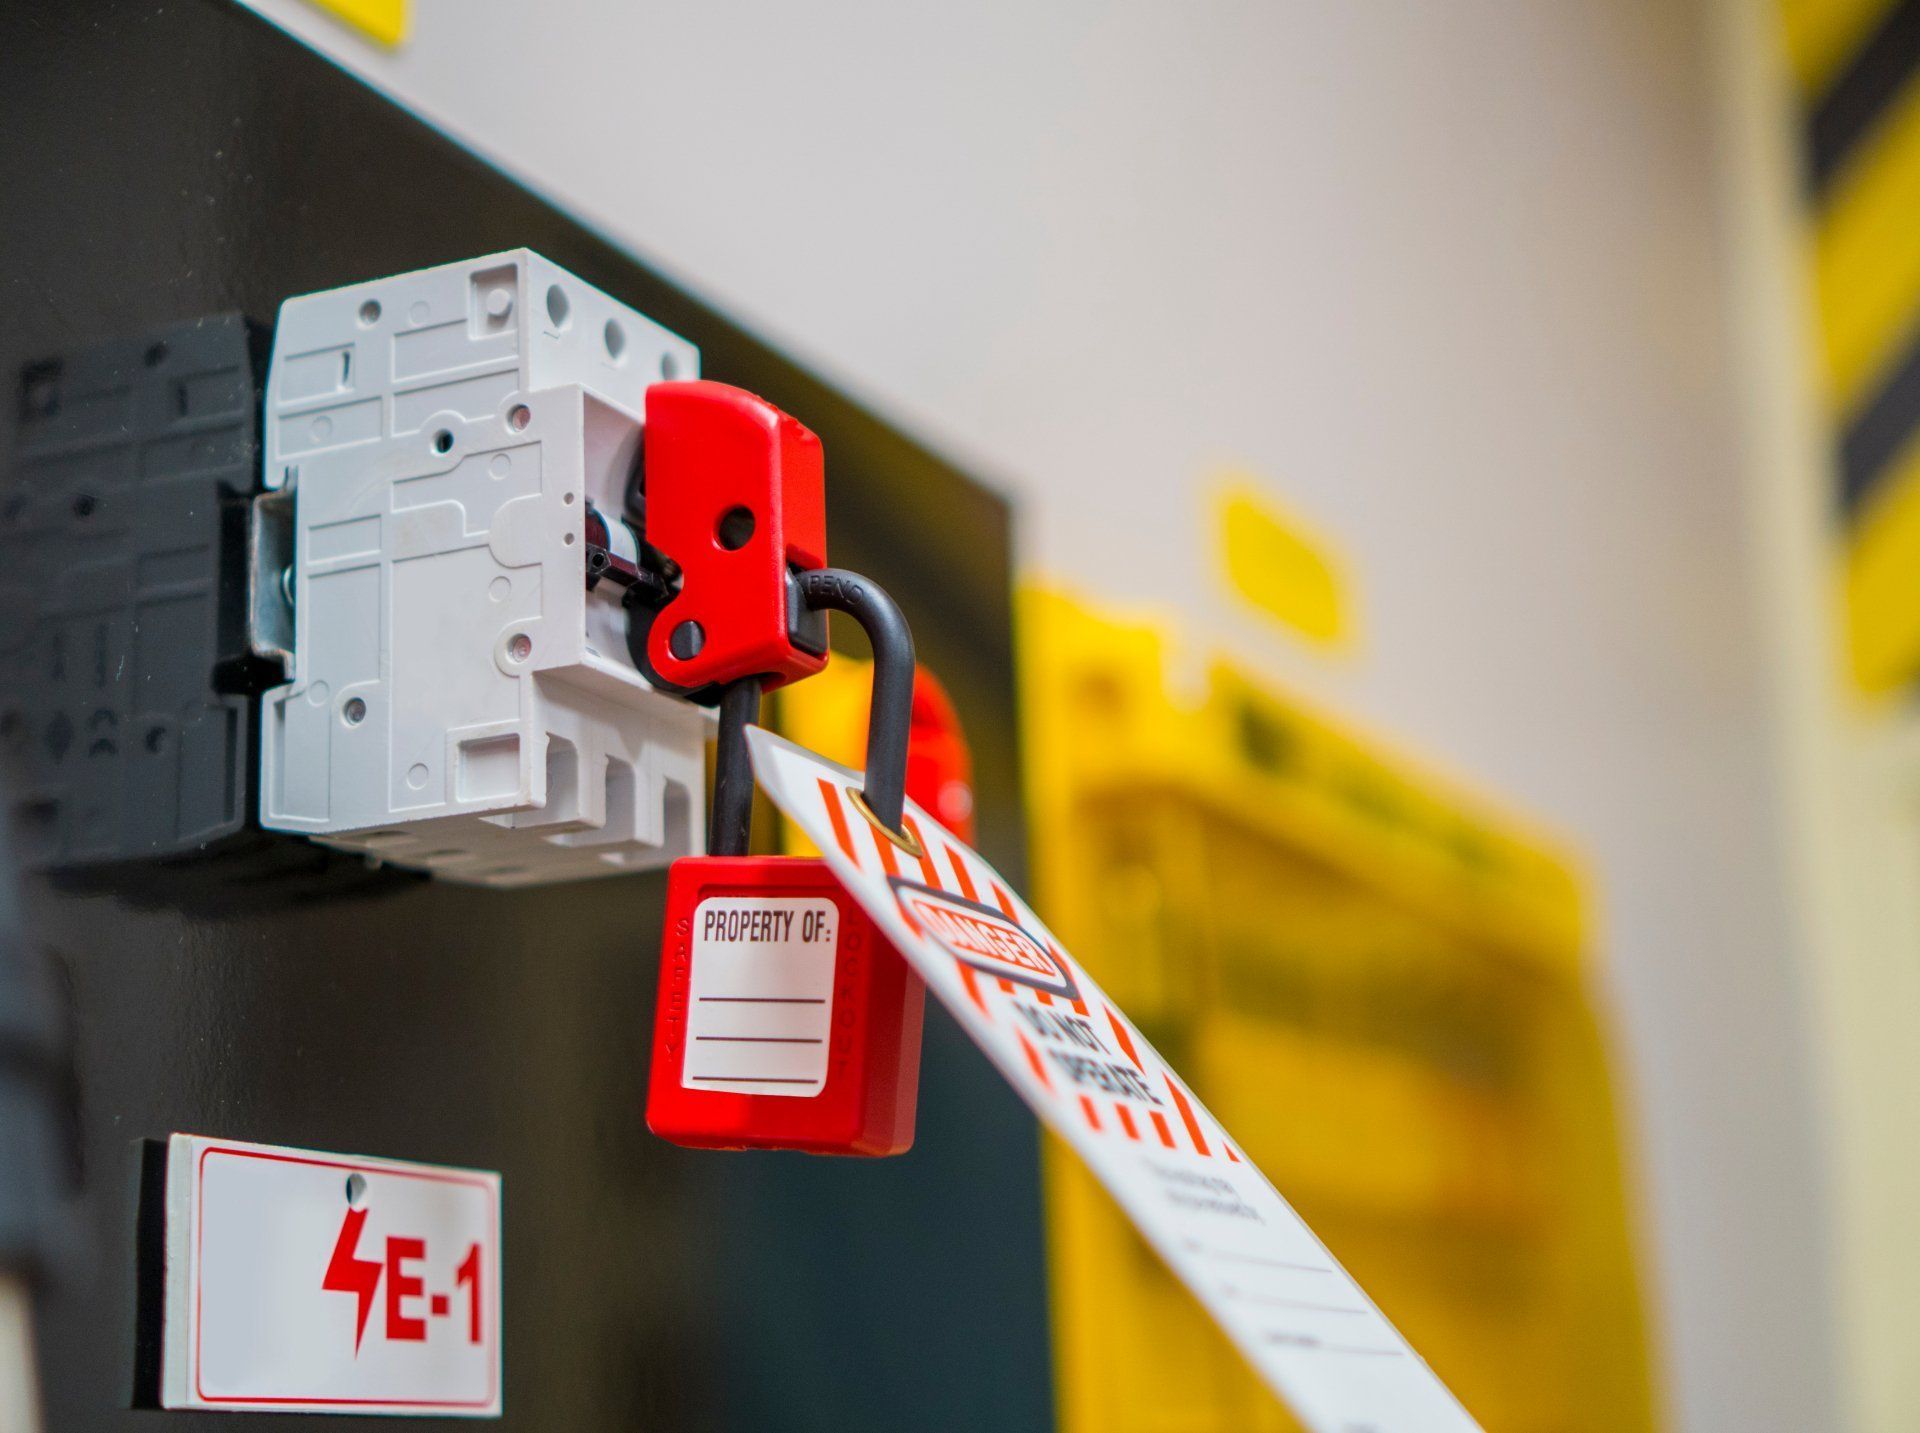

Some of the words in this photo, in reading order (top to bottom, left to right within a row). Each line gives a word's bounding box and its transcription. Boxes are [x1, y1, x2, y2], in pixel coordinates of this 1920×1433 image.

[703, 909, 795, 942] PROPERTY
[801, 909, 831, 942] OF:
[912, 899, 1056, 977] DANGER
[665, 919, 690, 1062] SAFETY
[838, 907, 862, 1077] LOCKOUT
[1047, 1010, 1112, 1056] NOT
[1047, 1047, 1164, 1106] OPERATE
[385, 1235, 484, 1346] E-1
